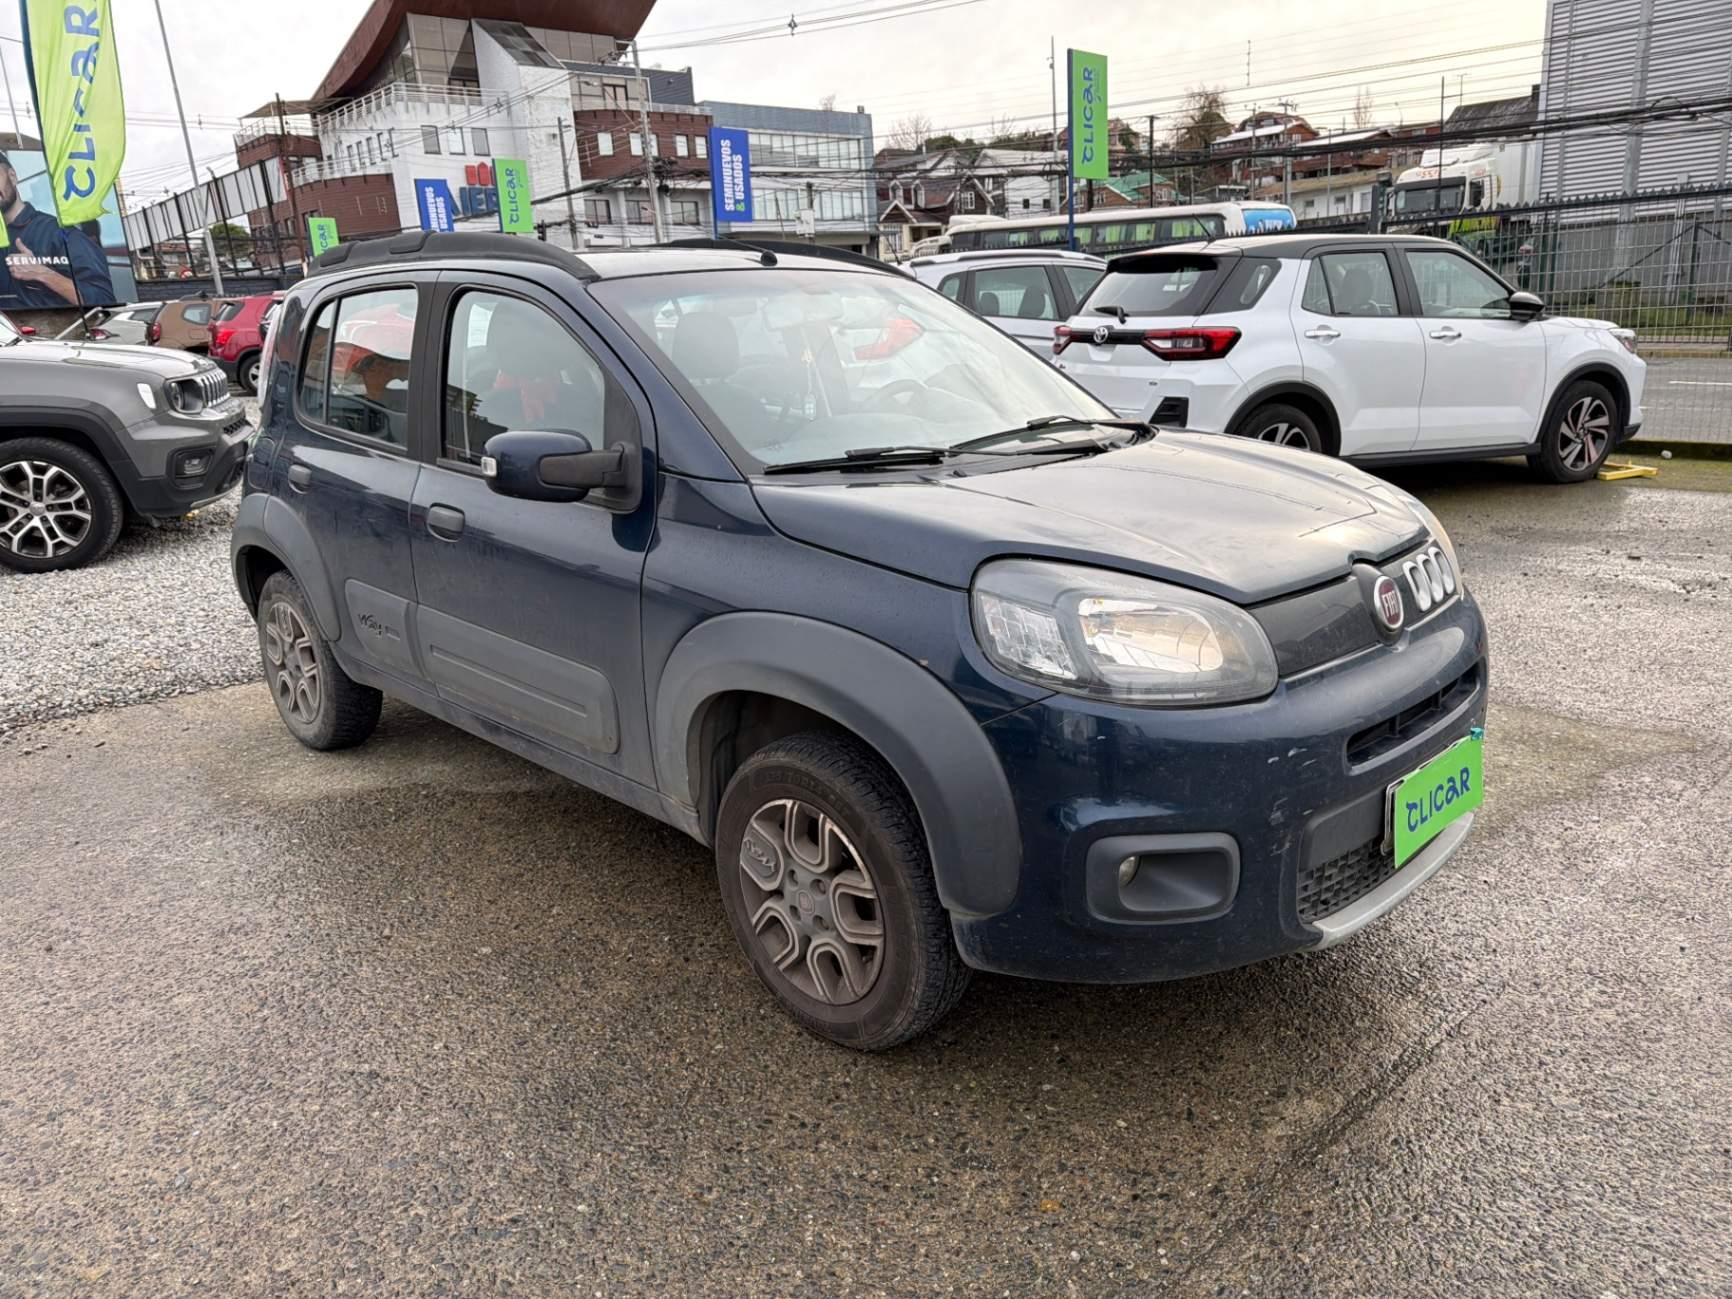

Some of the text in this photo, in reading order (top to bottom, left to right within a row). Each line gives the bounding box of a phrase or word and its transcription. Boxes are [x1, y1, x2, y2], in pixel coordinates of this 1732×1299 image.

[720, 139, 735, 211] SEMINUEVOS
[732, 154, 746, 212] & USADOS
[435, 197, 448, 229] USADOS
[5, 256, 70, 266] SERVIMAQ
[1381, 590, 1399, 618] FIAT
